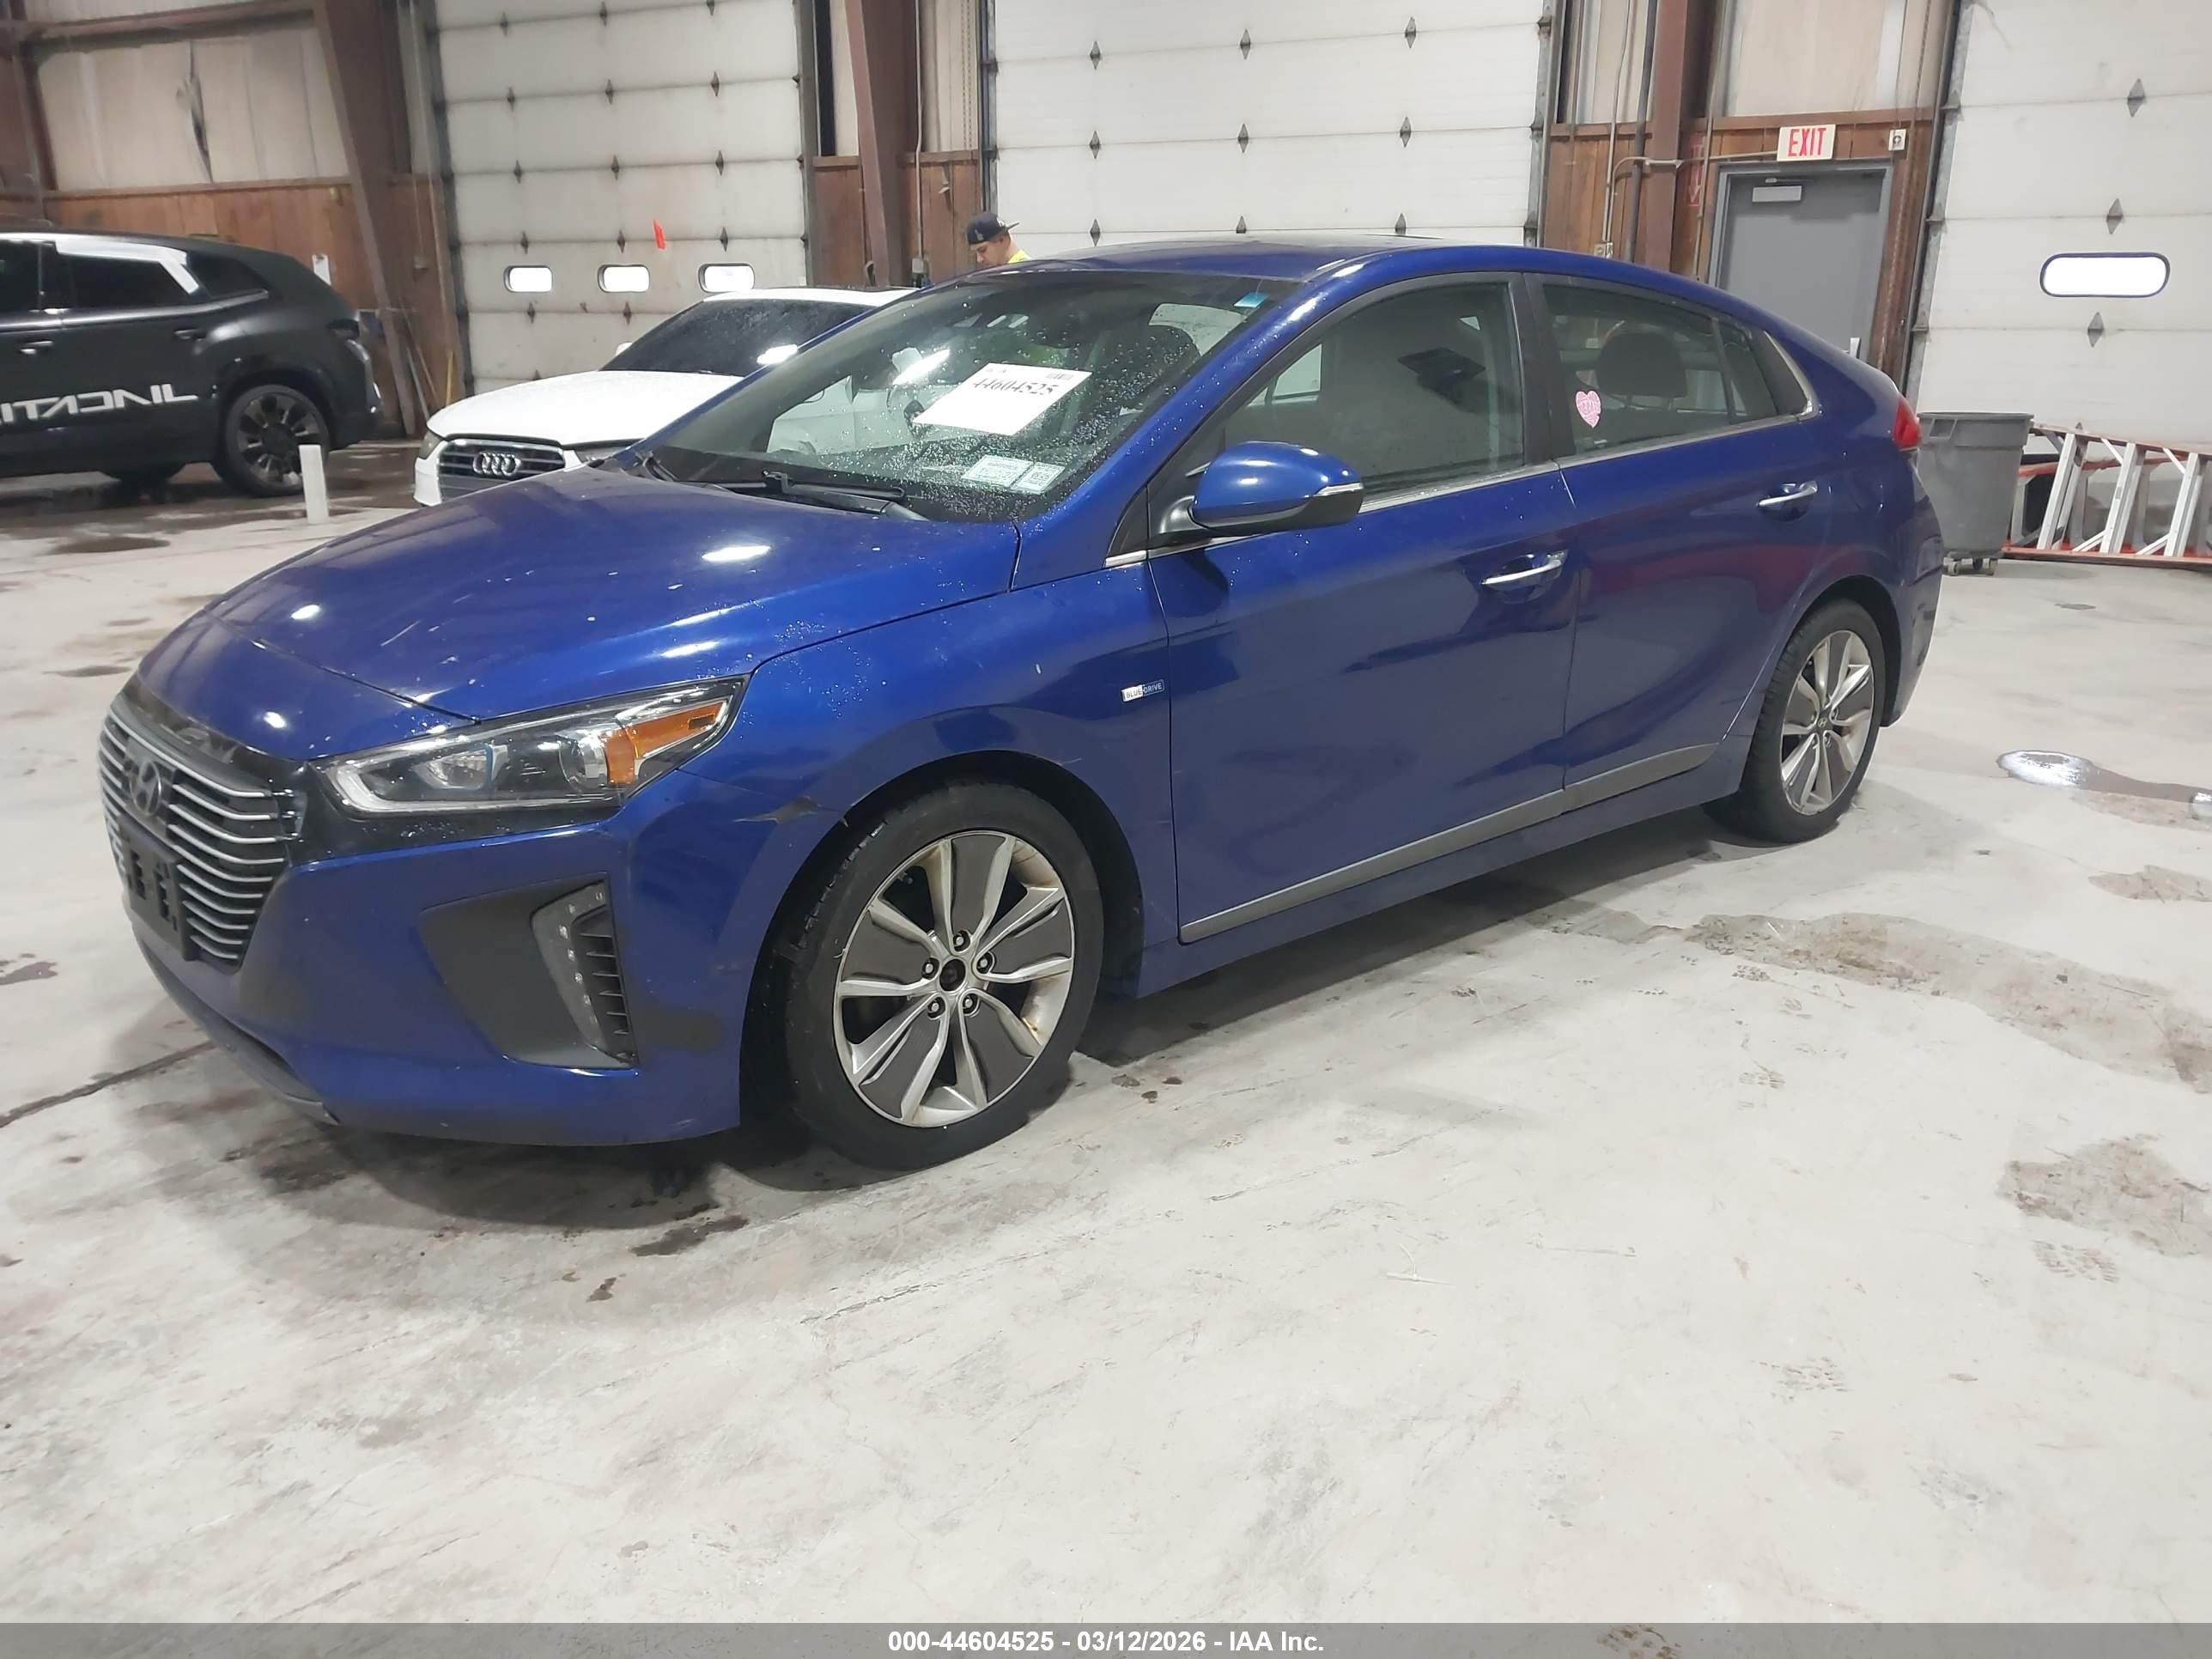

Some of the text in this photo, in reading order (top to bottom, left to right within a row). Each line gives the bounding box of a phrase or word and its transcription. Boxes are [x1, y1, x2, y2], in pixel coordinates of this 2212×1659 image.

[1787, 127, 1827, 157] EXIT
[972, 378, 1058, 395] 44604525
[1126, 682, 1163, 699] BLUE DRIVE
